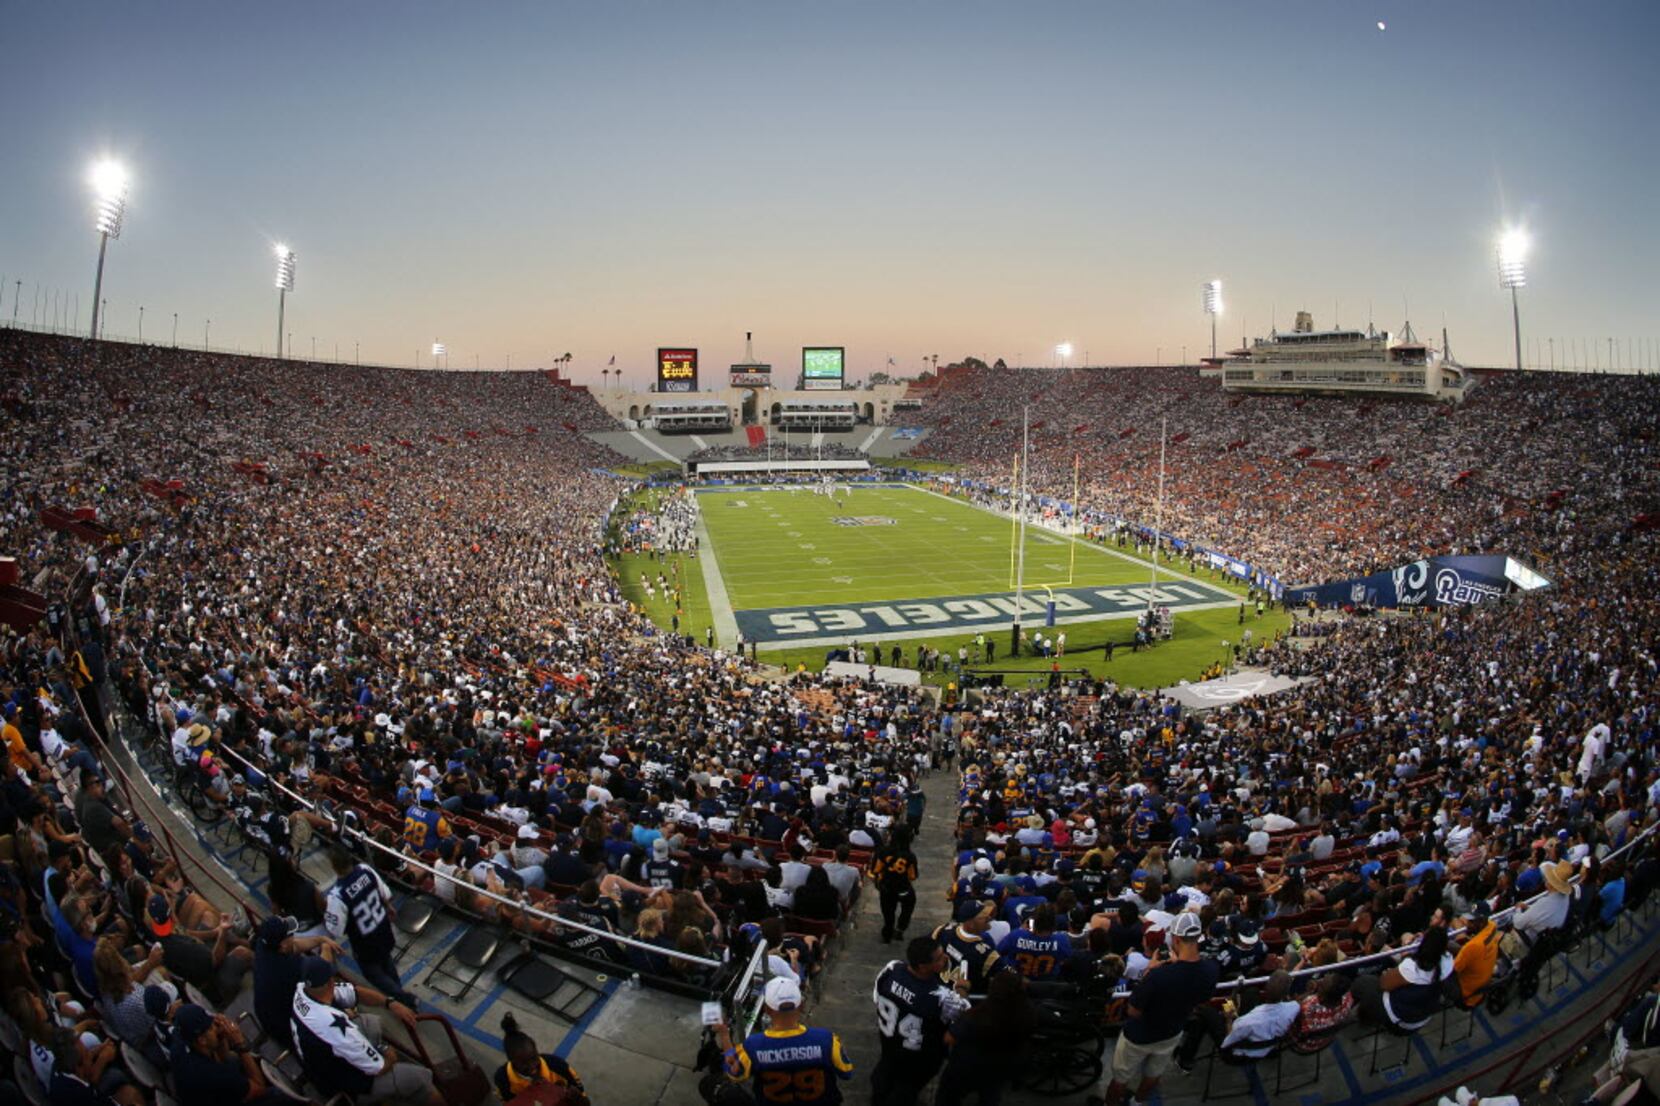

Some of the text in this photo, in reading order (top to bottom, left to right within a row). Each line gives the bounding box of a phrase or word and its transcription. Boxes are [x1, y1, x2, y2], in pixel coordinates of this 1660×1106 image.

[770, 584, 1206, 635] LOS ANGELES
[403, 816, 429, 848] 28
[351, 888, 387, 936] 22
[890, 980, 916, 1006] WARE
[878, 994, 925, 1052] 94
[755, 1045, 822, 1064] DICKERSON
[759, 1068, 825, 1105] 29
